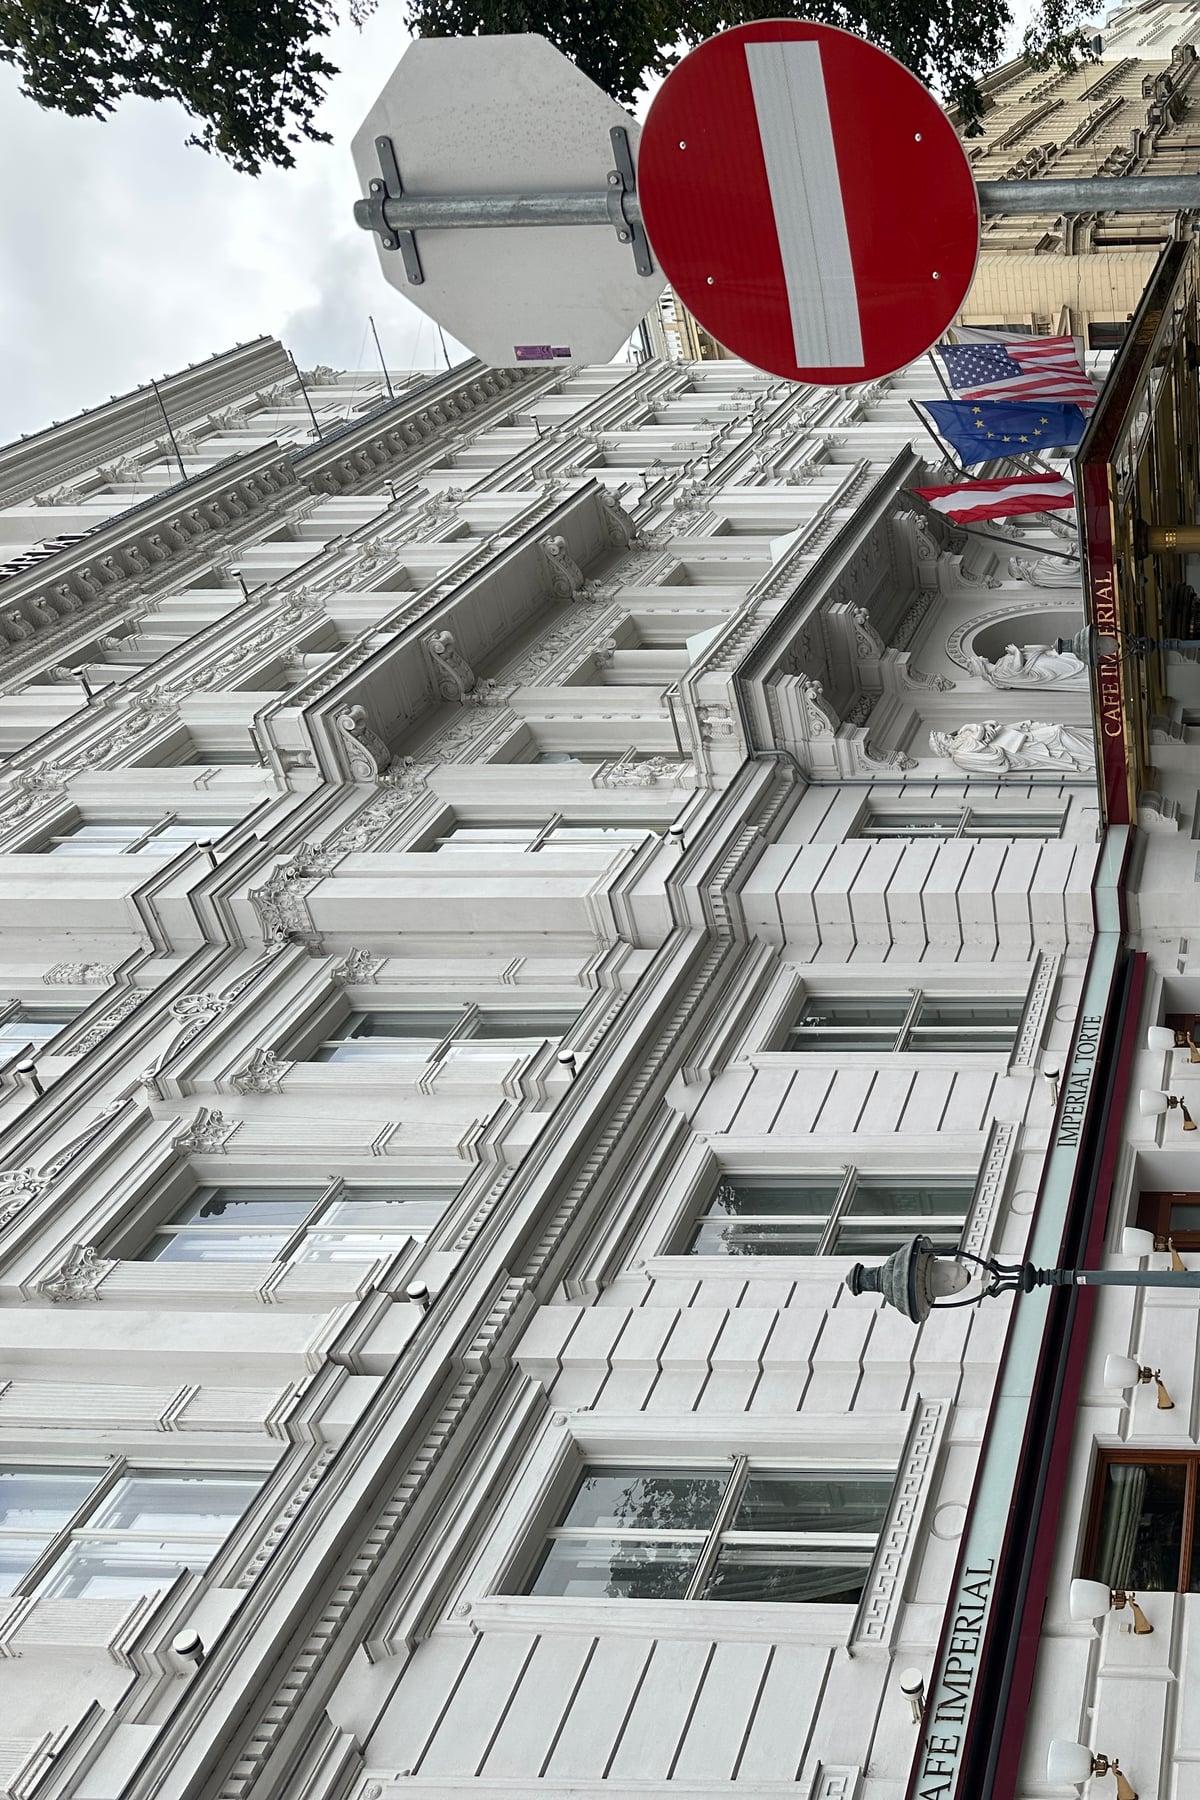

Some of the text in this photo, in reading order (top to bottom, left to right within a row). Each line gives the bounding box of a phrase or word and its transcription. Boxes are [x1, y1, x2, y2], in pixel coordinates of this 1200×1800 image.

[1095, 571, 1122, 737] CAFE IMERIAL
[1056, 1016, 1102, 1148] IMPERIAL TORTE
[934, 1558, 994, 1724] IMPERIAL
